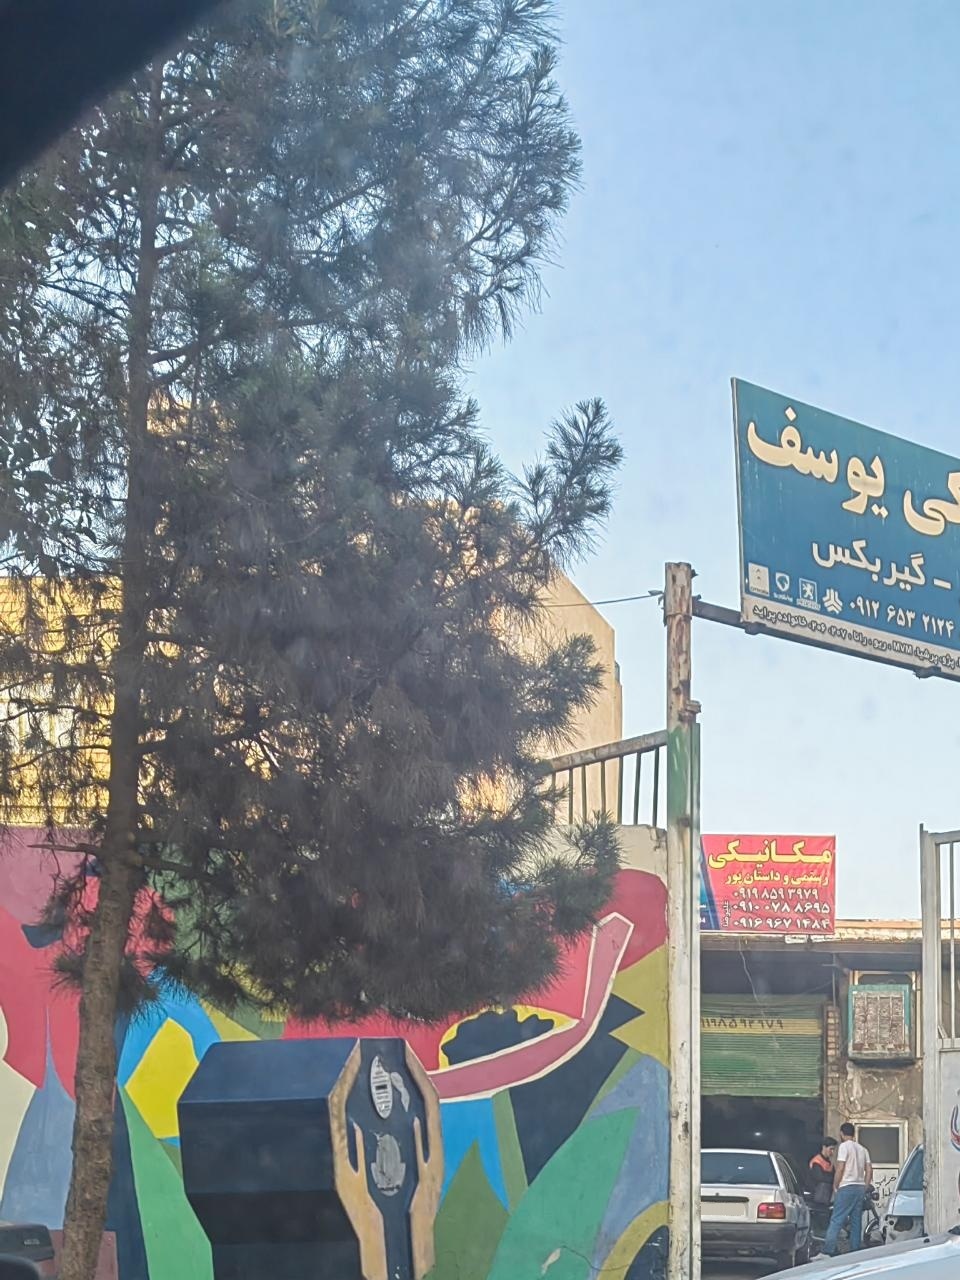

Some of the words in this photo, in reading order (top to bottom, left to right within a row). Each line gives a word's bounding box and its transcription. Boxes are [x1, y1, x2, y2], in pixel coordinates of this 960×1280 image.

[747, 406, 888, 519] یوسف
[812, 540, 925, 590] گیربکس
[849, 596, 880, 620] ۰۹۱۲
[887, 604, 916, 629] ۶۵۳
[708, 839, 832, 869] مکانیکی
[783, 874, 790, 885] و
[791, 870, 829, 886] رستمی
[733, 887, 759, 899] ۰۹۱۹
[761, 887, 785, 900] ۸۵۹
[787, 887, 819, 900] ۳۹۷۹
[733, 900, 760, 912] ۰۹۱۰
[764, 901, 791, 913] ۰۷۸
[794, 901, 831, 914] ۸۶۹۵
[733, 918, 763, 929] ۰۹۱۶
[766, 918, 793, 929] ۹۶۷
